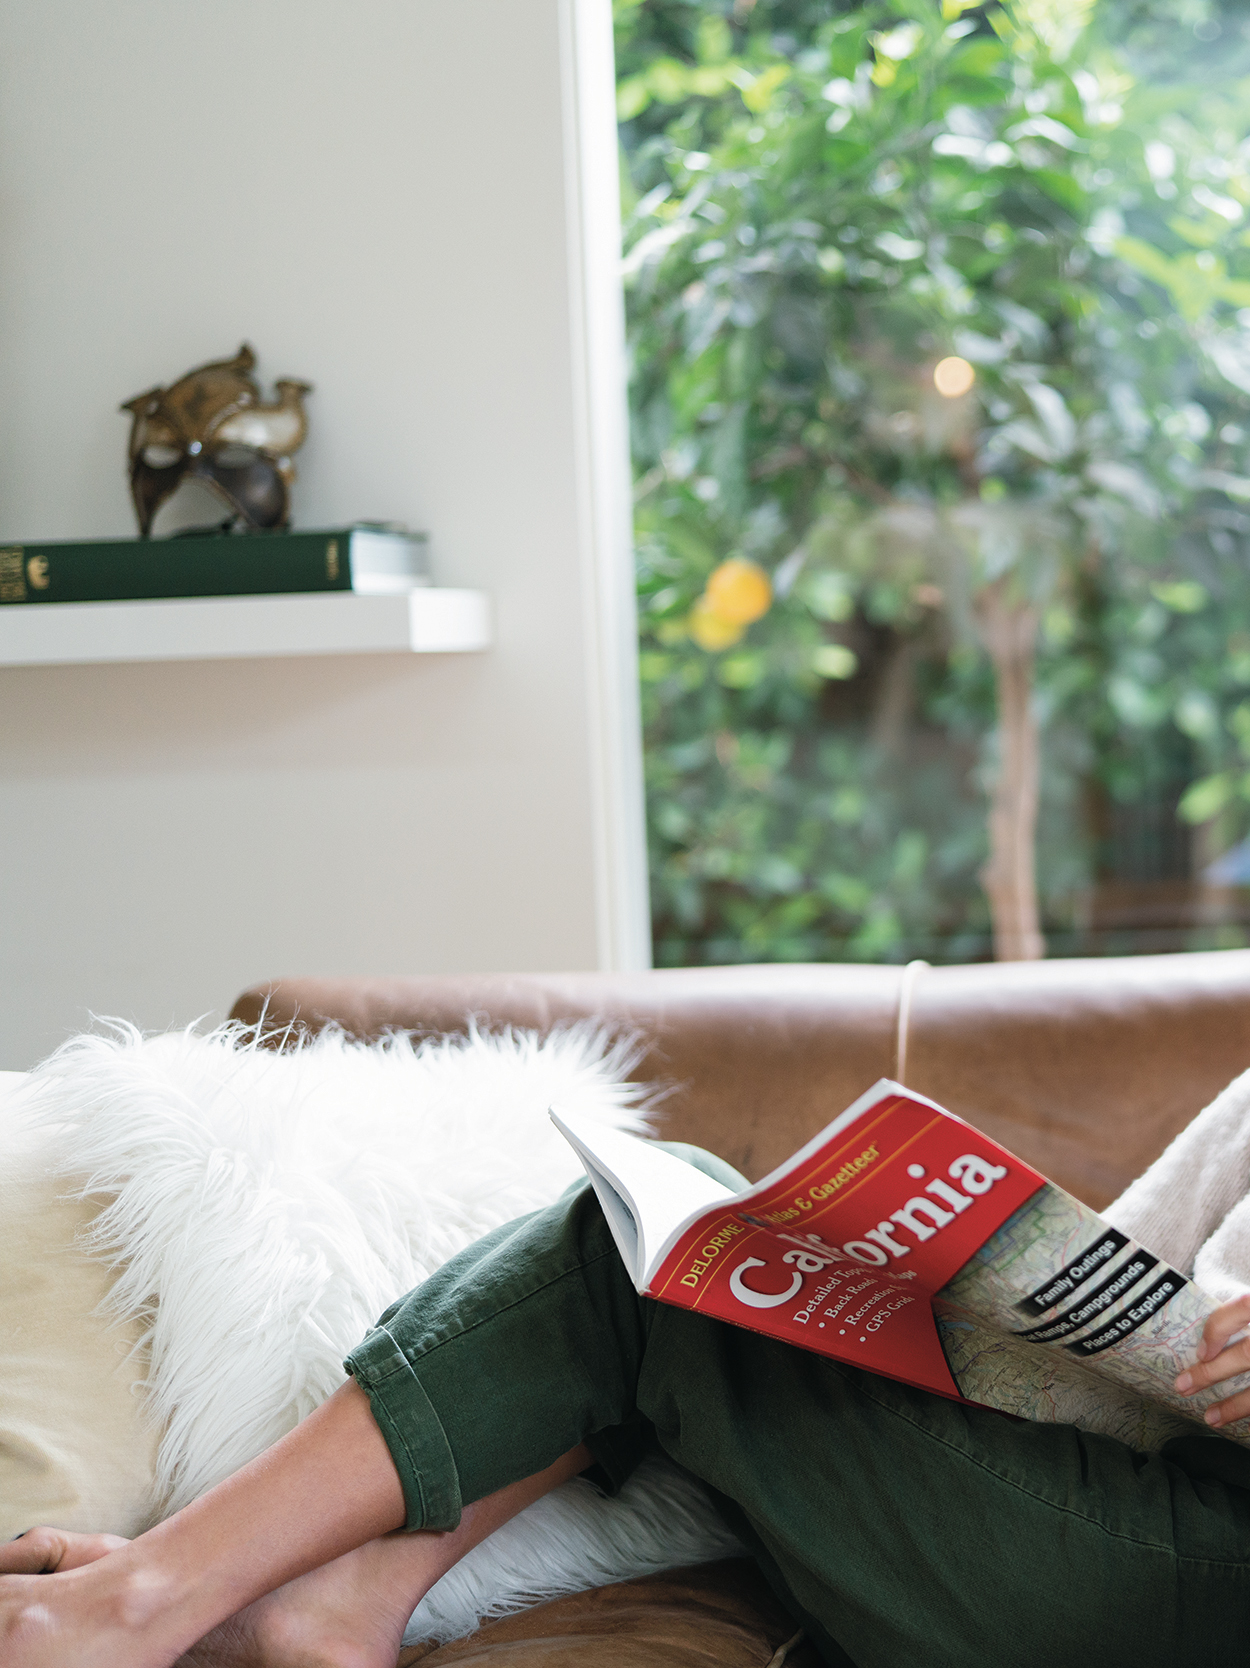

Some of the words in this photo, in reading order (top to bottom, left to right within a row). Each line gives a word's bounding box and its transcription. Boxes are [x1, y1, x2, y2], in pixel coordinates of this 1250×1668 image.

[794, 1197, 813, 1211] &
[808, 1143, 880, 1200] Gazetteer
[729, 1152, 1008, 1309] Calfornia
[792, 1276, 842, 1325] Detailed
[823, 1294, 853, 1319] Back
[844, 1287, 896, 1326] Recreation
[1033, 1275, 1076, 1307] Family
[1068, 1238, 1117, 1279] Outings
[1036, 1319, 1076, 1341] Ramps,
[1068, 1260, 1146, 1324] Campgrounds
[865, 1309, 892, 1332] GPS
[1082, 1327, 1120, 1350] Places
[1115, 1318, 1132, 1333] to
[1127, 1280, 1175, 1321] Explore
